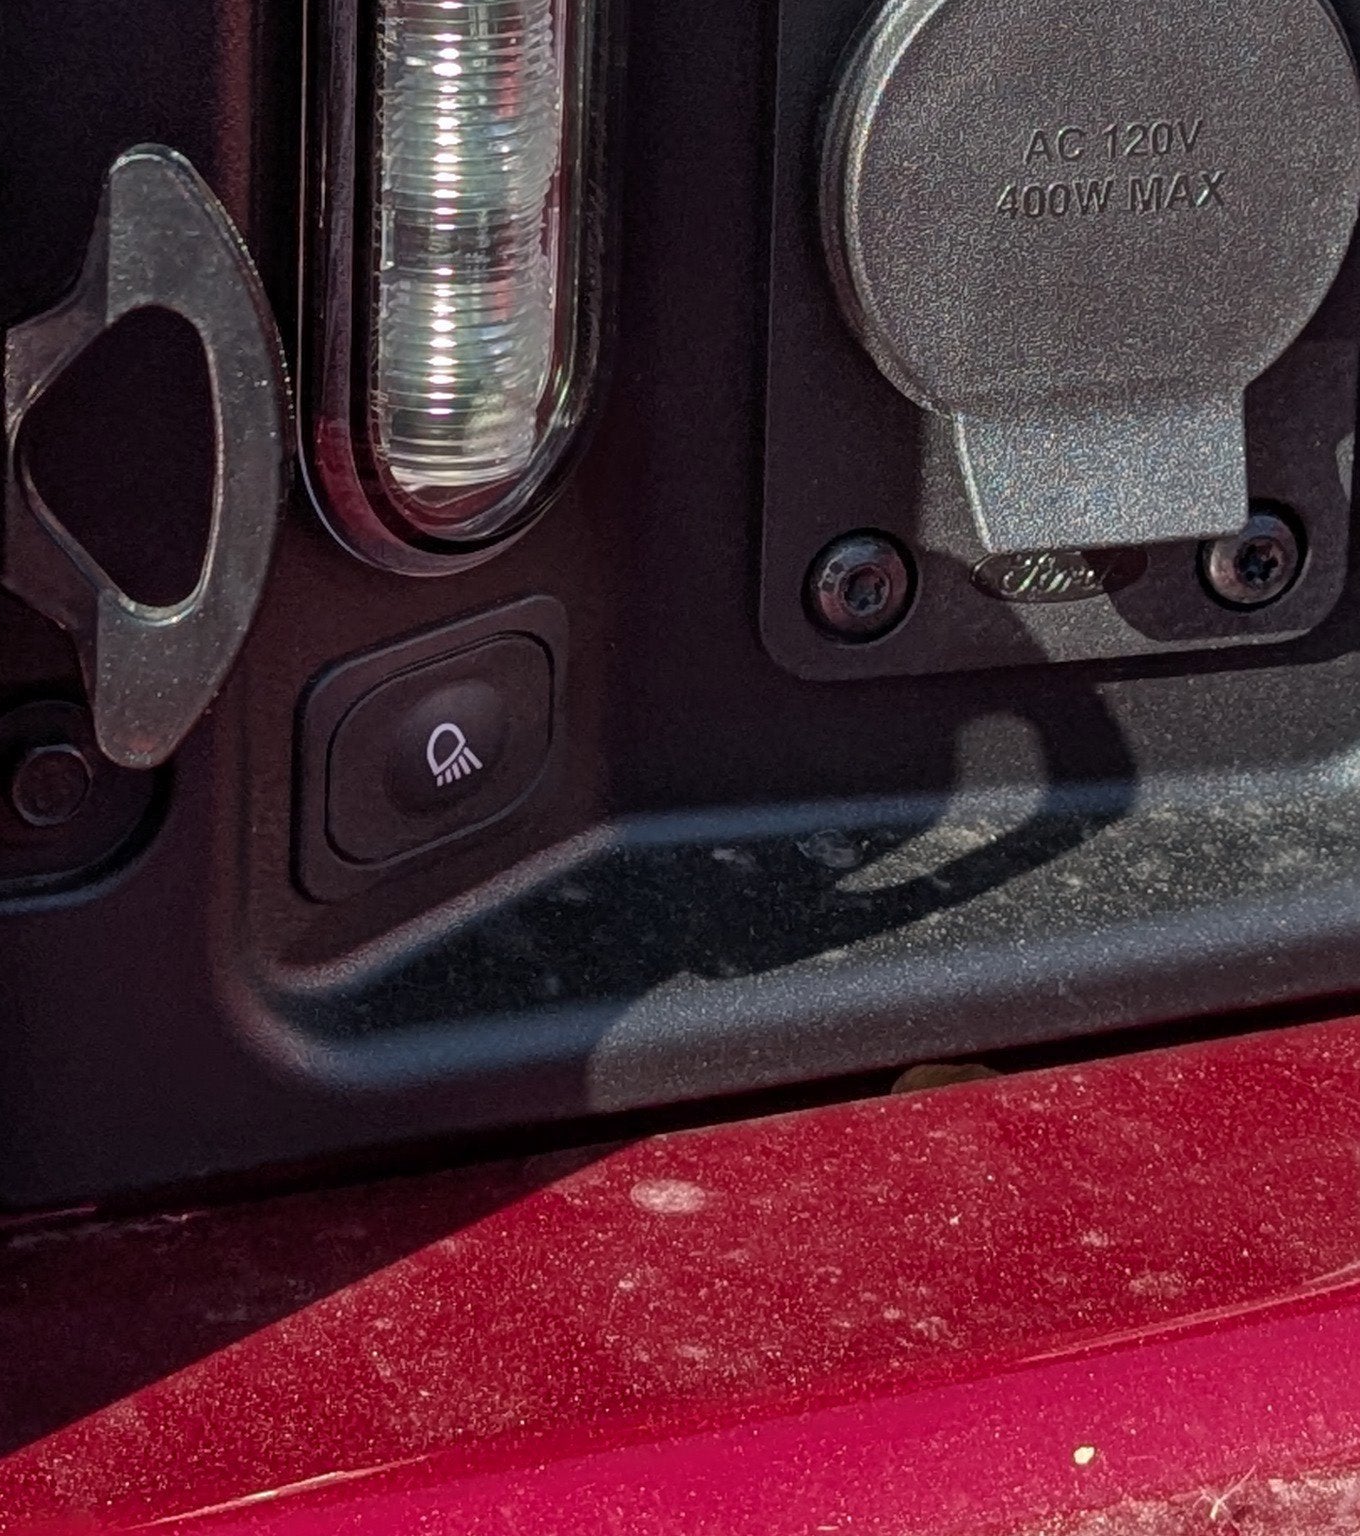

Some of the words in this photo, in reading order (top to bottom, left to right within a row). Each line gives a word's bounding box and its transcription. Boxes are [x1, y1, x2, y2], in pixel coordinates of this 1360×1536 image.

[1023, 125, 1086, 164] AC
[1102, 117, 1204, 161] 120V
[995, 176, 1115, 220] 400W
[1126, 169, 1227, 215] MAX
